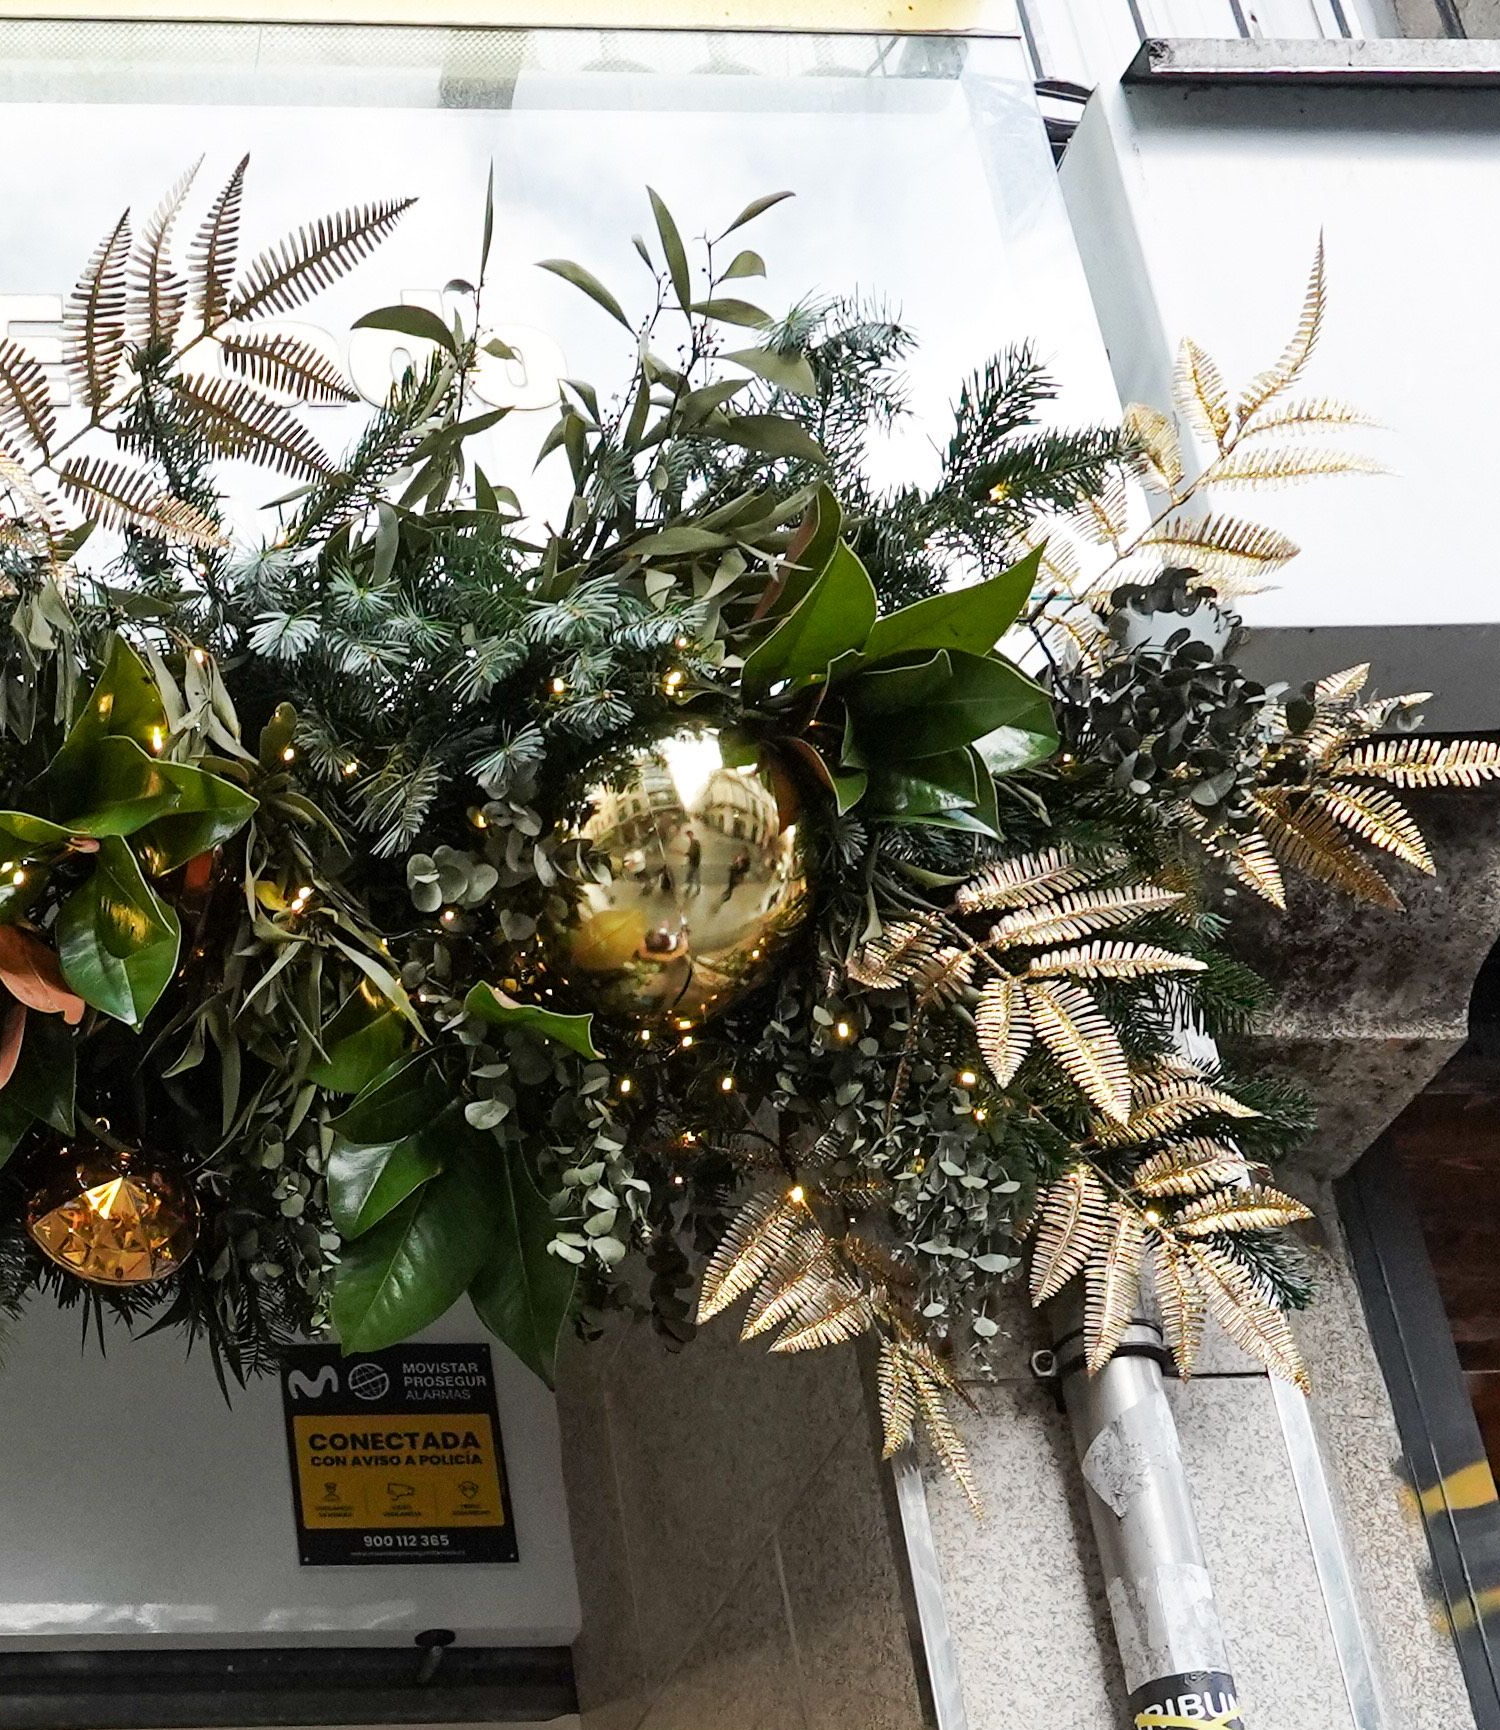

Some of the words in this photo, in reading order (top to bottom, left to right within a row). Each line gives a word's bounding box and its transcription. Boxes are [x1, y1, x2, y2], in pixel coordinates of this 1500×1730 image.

[402, 1363, 479, 1375] MOVISTAR
[403, 1376, 488, 1388] PROSEGUR
[405, 1389, 472, 1400] ALARMAS
[308, 1431, 481, 1452] CONECTADA
[311, 1455, 347, 1467] CON
[351, 1454, 401, 1466] AVISO
[405, 1454, 417, 1466] A
[420, 1451, 483, 1465] POLICÍA
[363, 1534, 393, 1548] 900
[397, 1534, 417, 1547] 112
[421, 1534, 450, 1547] 365
